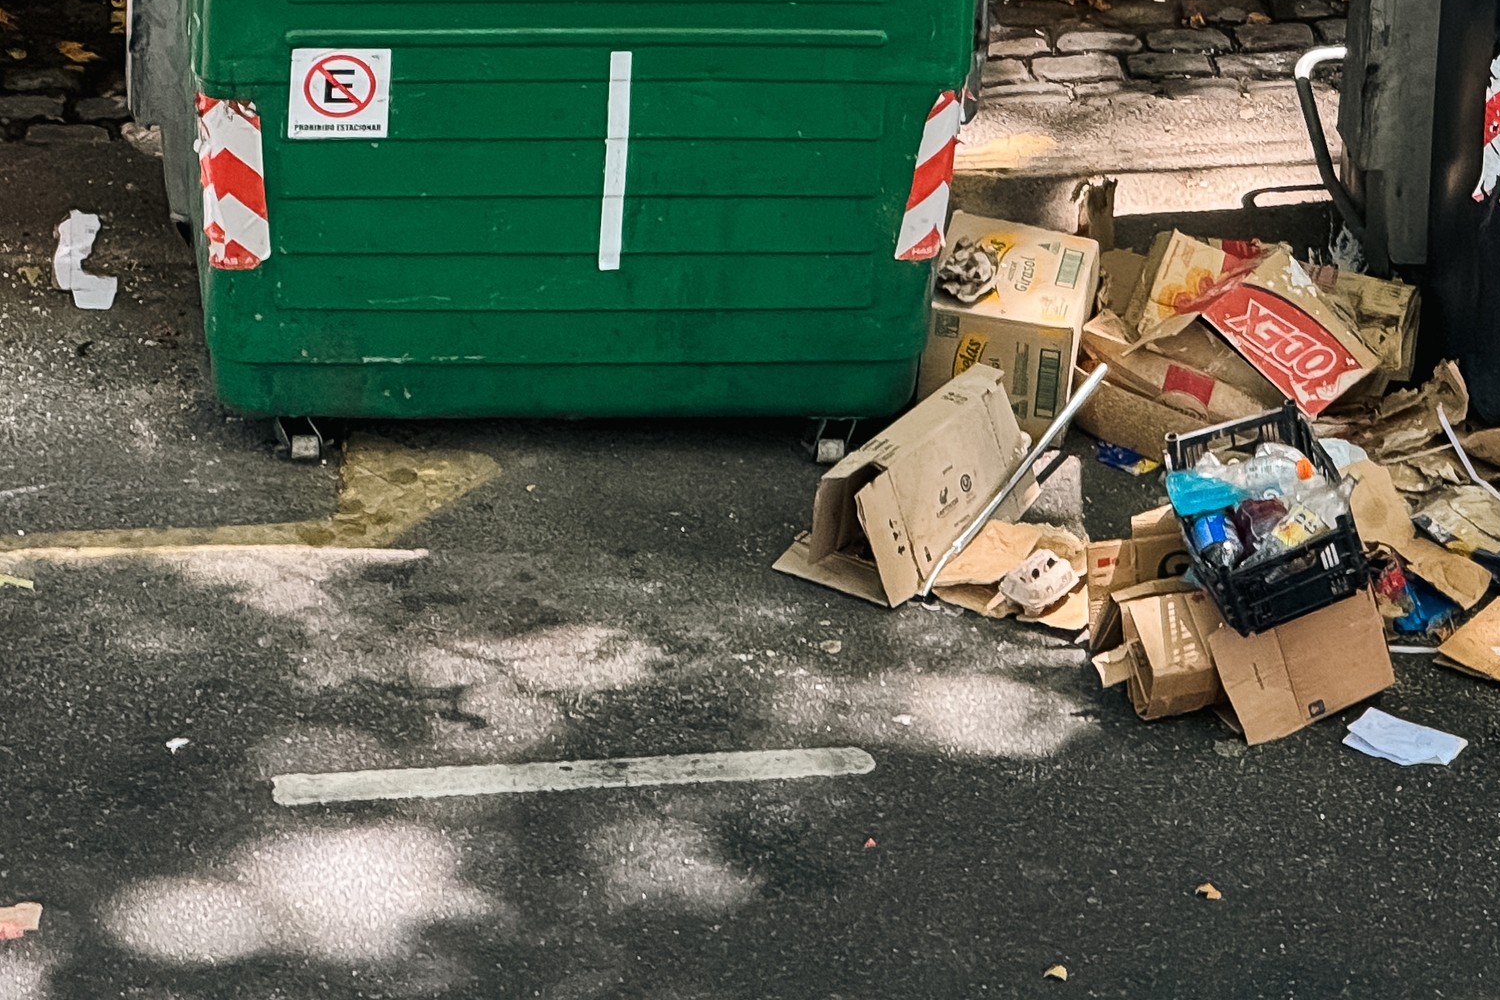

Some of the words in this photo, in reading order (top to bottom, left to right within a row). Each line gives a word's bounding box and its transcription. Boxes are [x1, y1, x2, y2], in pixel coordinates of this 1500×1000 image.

[324, 70, 355, 104] E
[294, 124, 335, 132] PROHIBIDO
[336, 124, 382, 132] ESTACIONAR
[1014, 256, 1036, 293] Girasol
